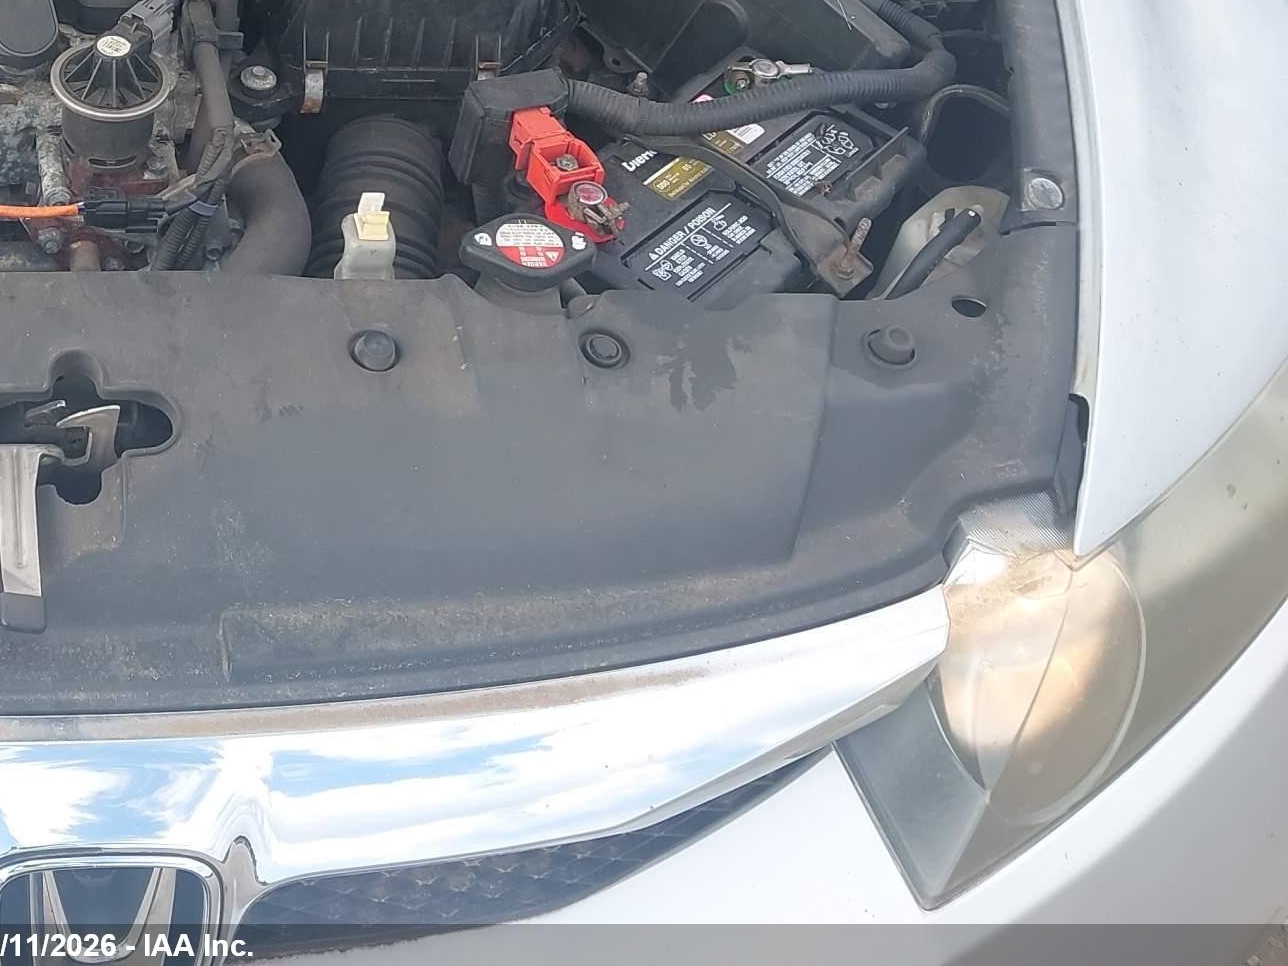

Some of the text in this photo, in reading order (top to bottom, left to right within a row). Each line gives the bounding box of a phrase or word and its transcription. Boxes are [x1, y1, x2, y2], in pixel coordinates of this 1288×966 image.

[654, 230, 687, 255] DANGER
[683, 225, 690, 234] /
[687, 207, 716, 229] POISON
